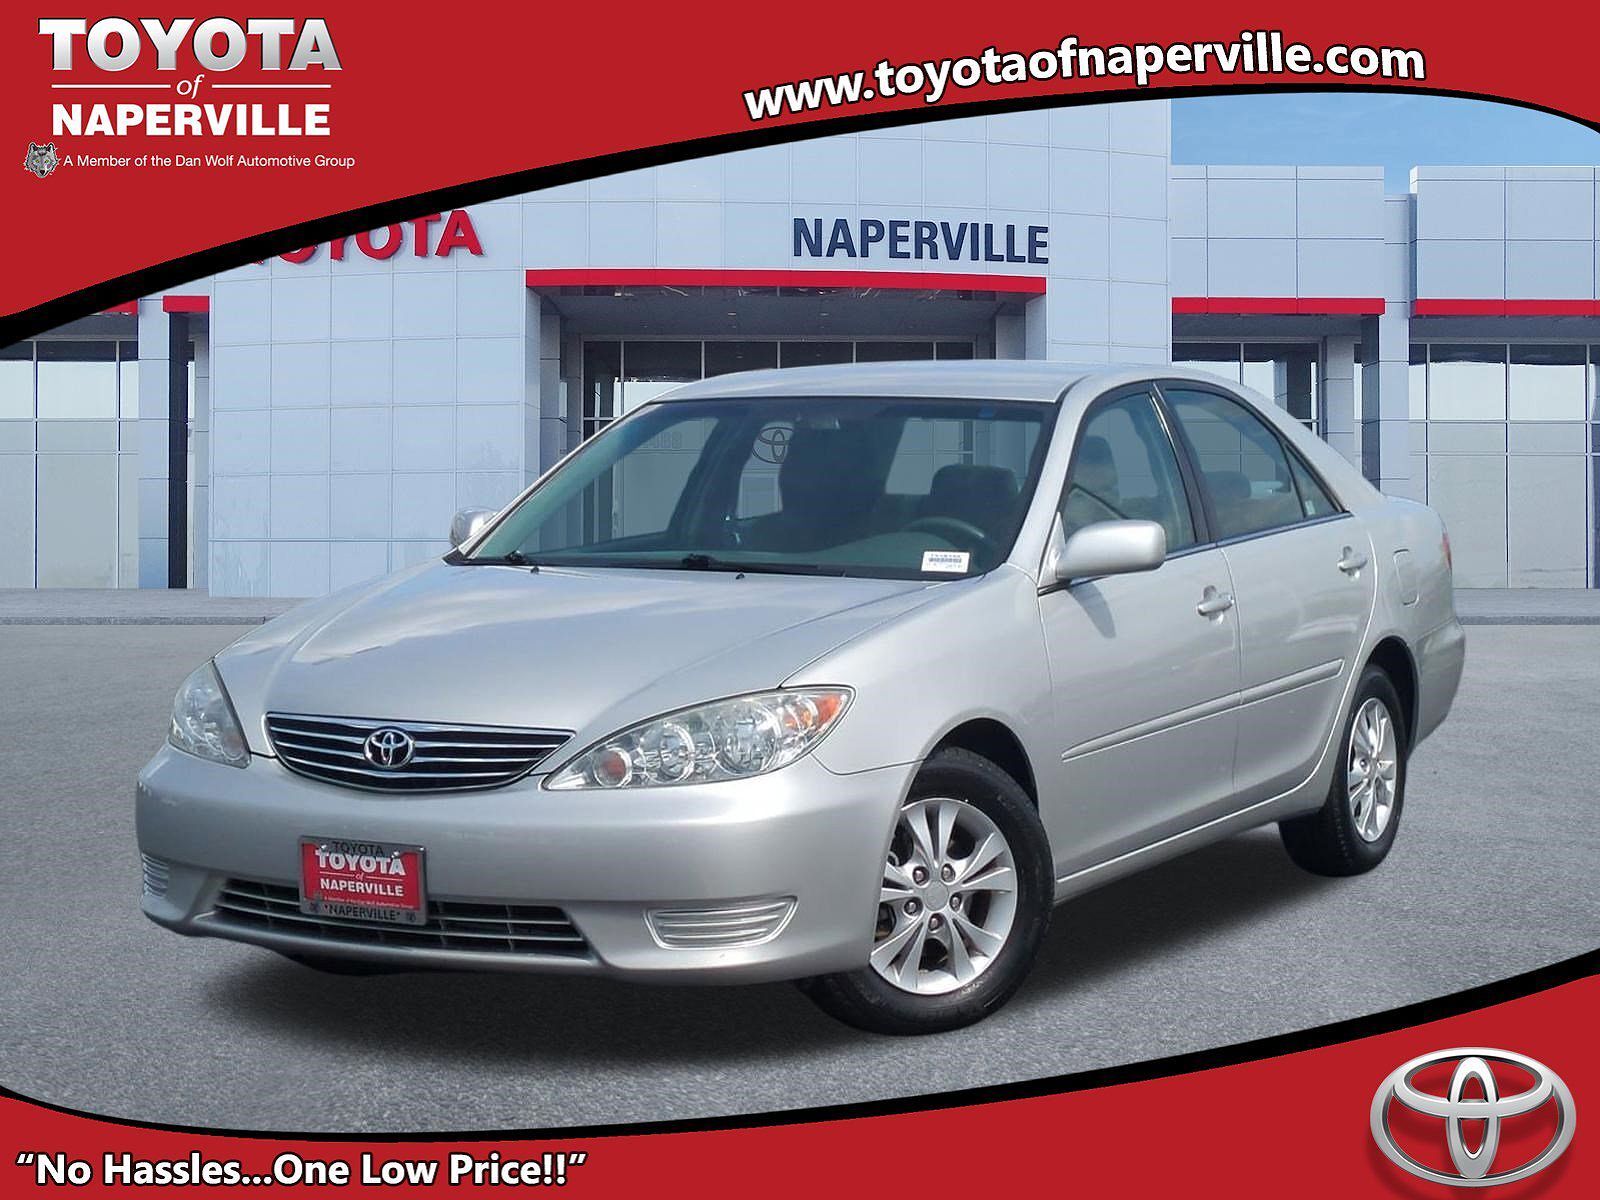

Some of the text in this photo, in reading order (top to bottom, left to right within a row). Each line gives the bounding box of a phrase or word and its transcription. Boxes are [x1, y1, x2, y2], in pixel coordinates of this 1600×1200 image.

[793, 217, 1049, 265] NAPERVILLE
[333, 841, 384, 856] TOYOTA
[315, 848, 406, 876] TOYOTA
[320, 878, 404, 897] NAPERVILLE
